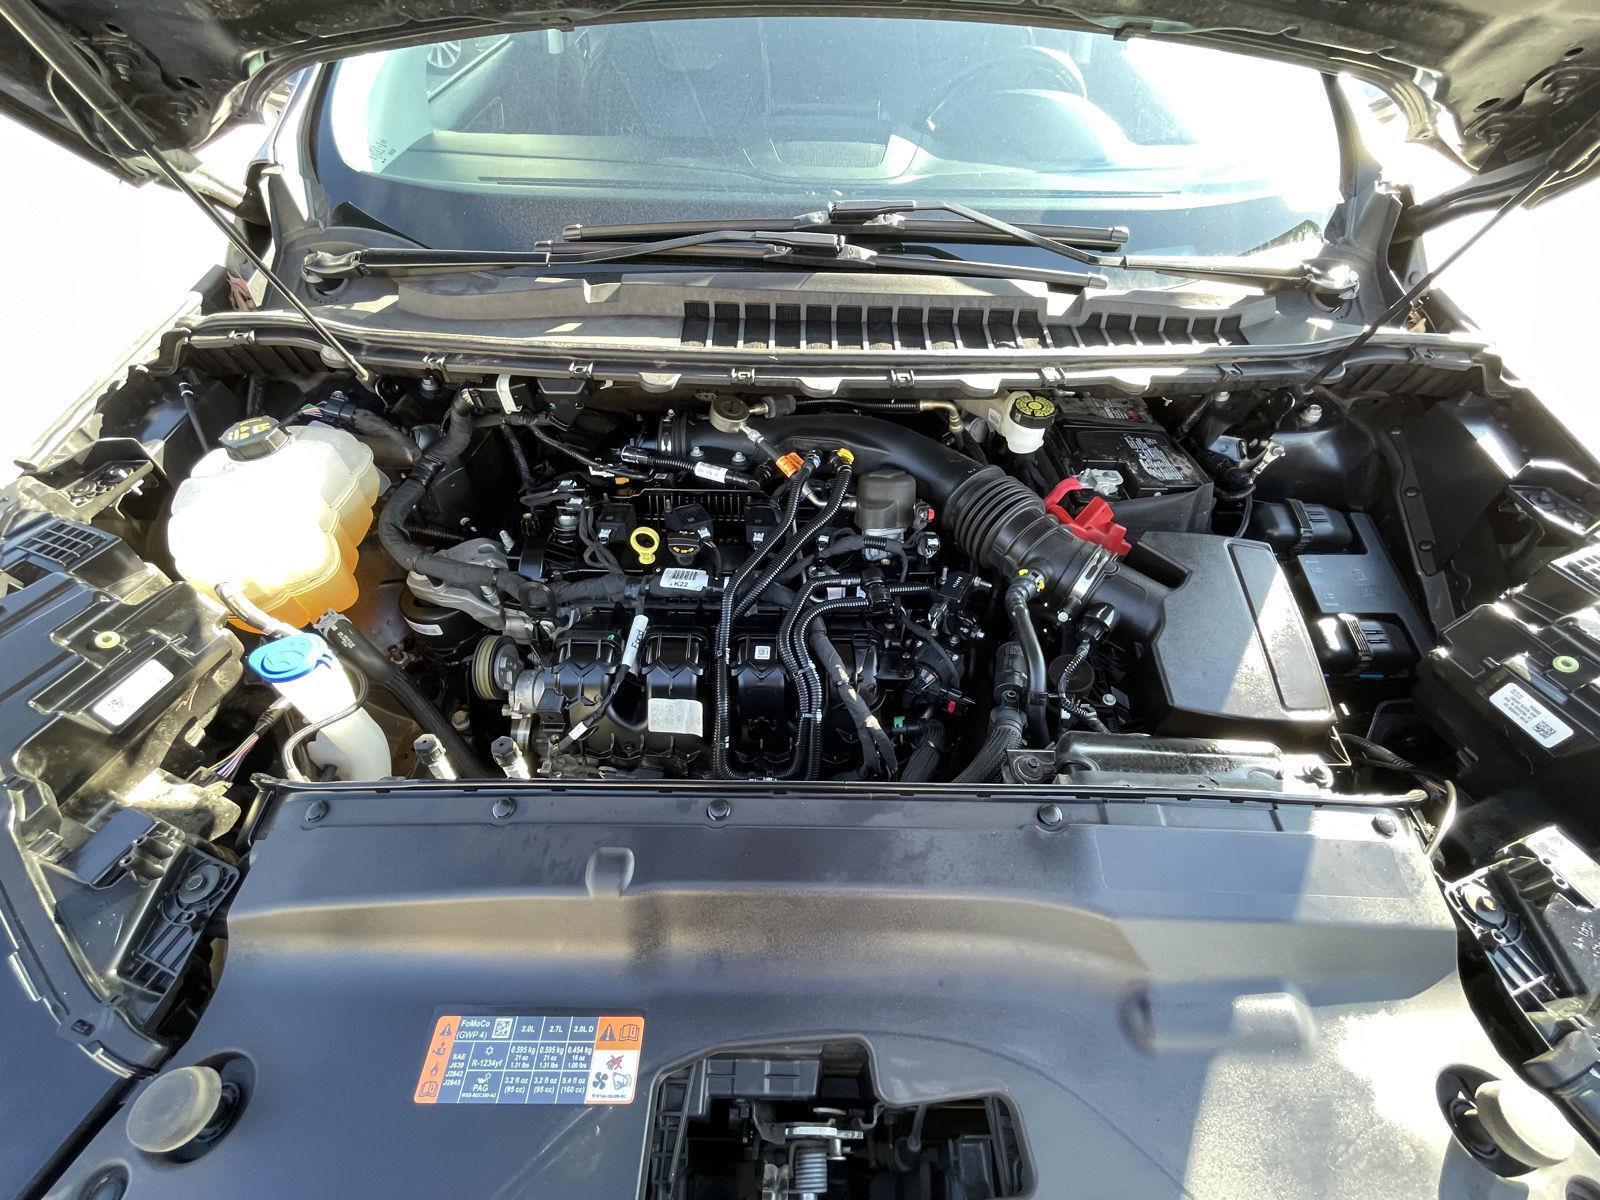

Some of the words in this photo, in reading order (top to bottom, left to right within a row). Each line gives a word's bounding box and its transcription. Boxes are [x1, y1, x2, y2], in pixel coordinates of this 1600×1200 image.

[456, 1032, 478, 1040] (GWP
[479, 1032, 487, 1040] 4)
[529, 1046, 536, 1055] kg
[557, 1047, 564, 1055] kg
[585, 1047, 592, 1055] kg
[472, 1059, 502, 1068] R-1234yf
